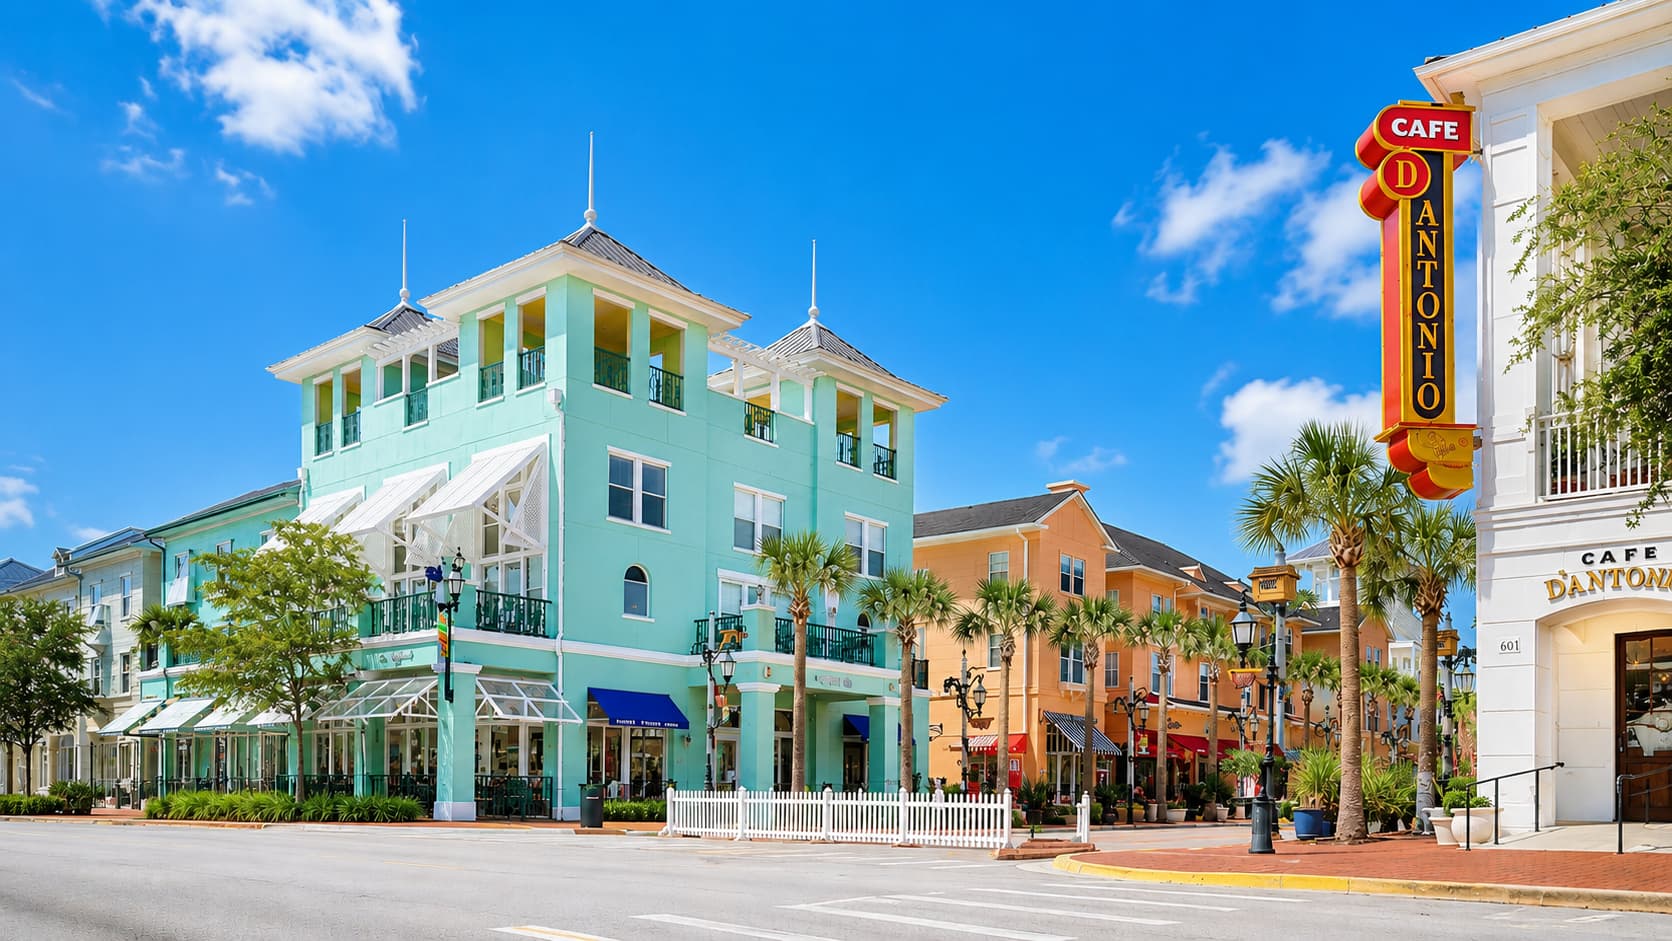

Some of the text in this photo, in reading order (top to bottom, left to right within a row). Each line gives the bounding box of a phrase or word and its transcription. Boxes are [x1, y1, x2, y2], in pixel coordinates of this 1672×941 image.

[1391, 117, 1459, 141] CAFE
[1581, 546, 1657, 565] CAFE
[1500, 639, 1519, 652] 601
